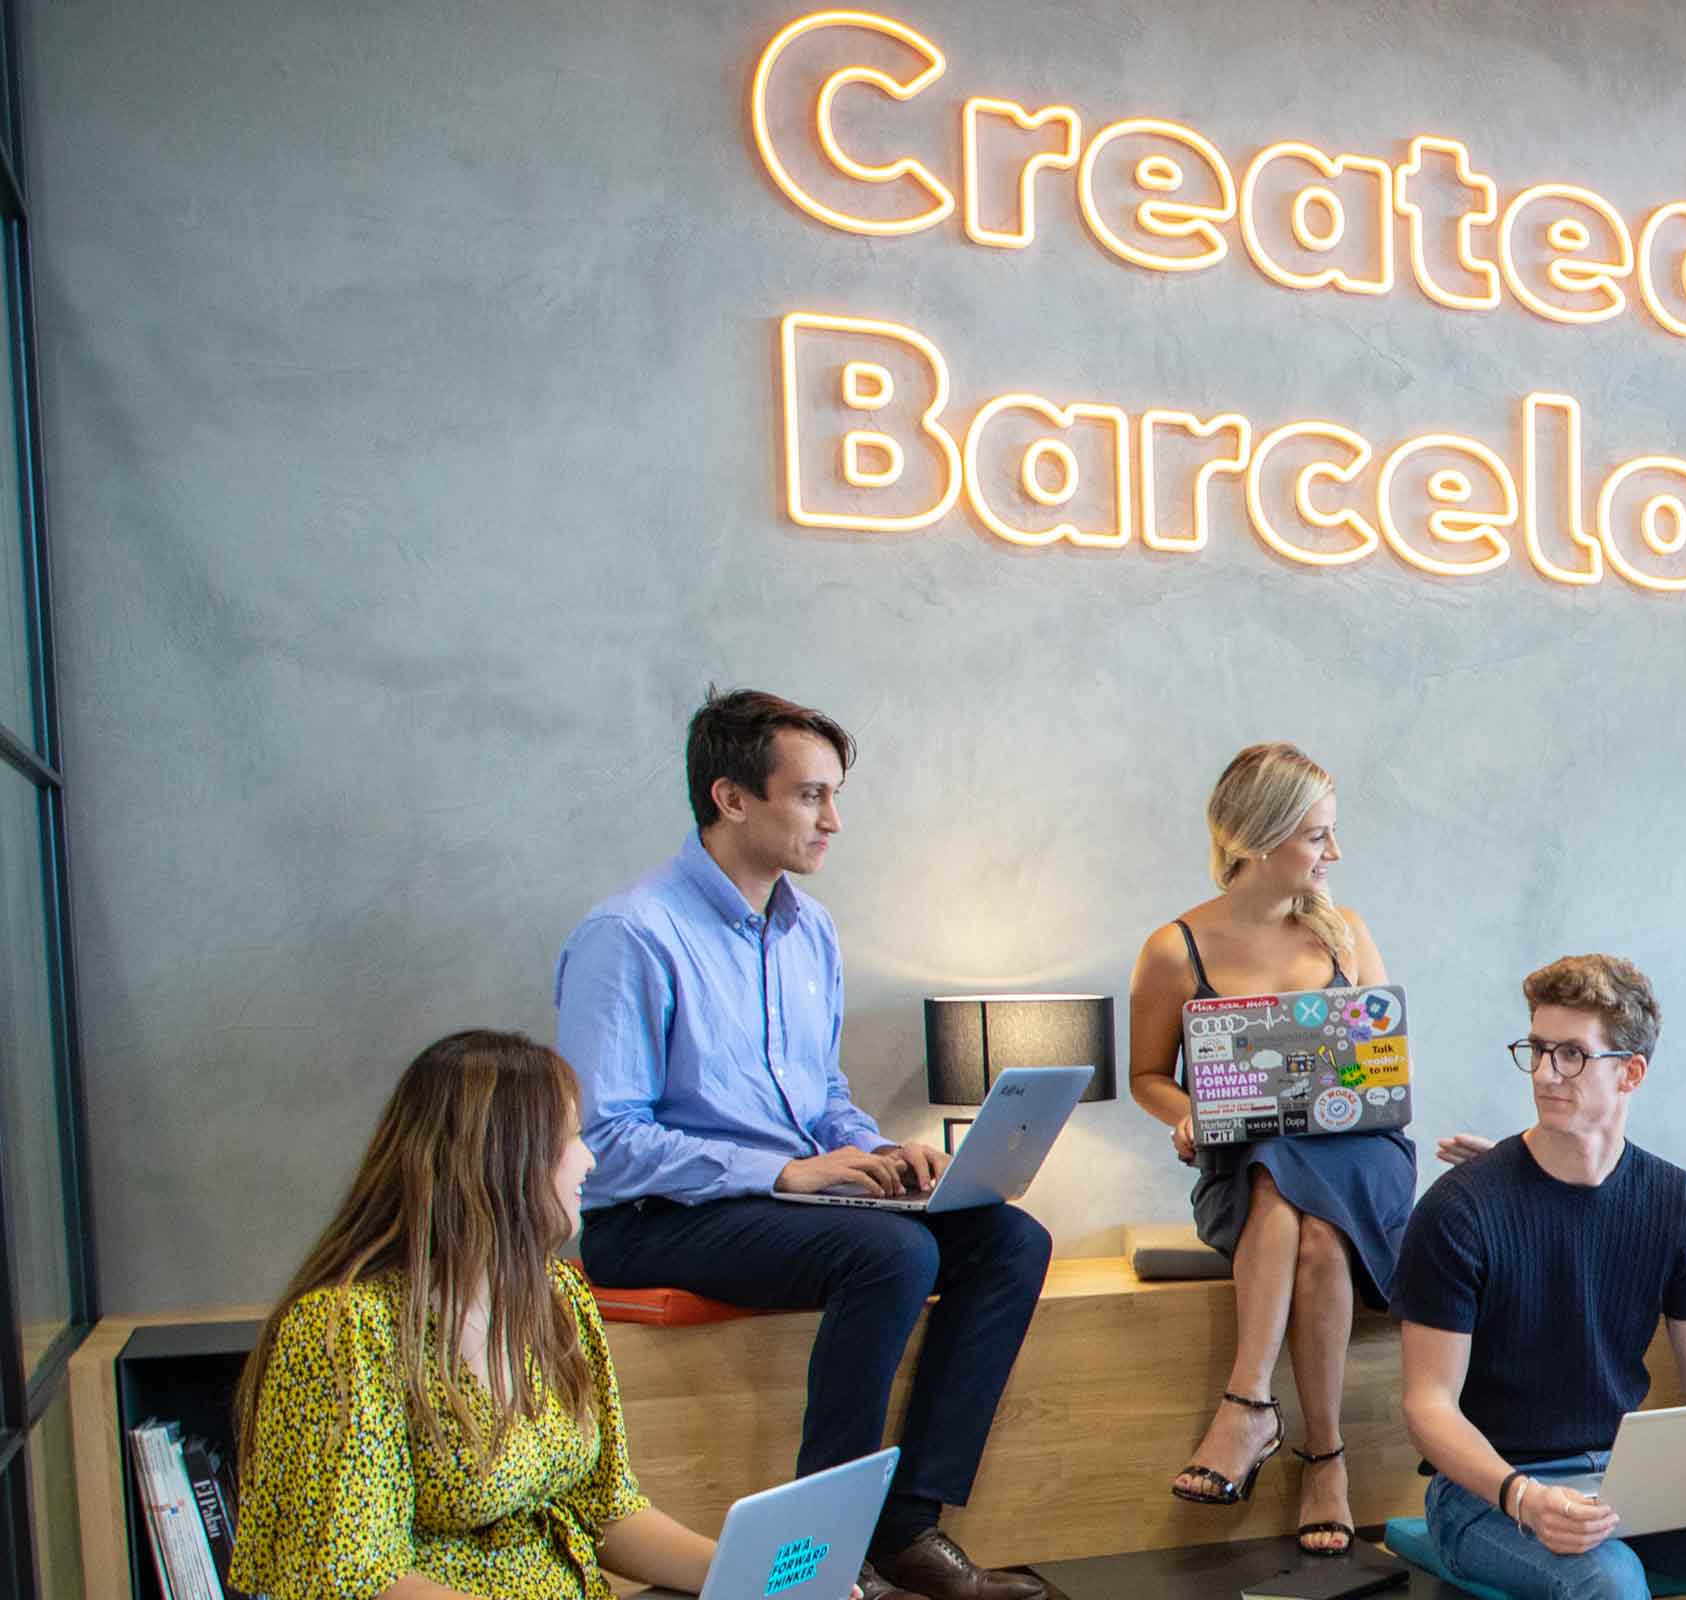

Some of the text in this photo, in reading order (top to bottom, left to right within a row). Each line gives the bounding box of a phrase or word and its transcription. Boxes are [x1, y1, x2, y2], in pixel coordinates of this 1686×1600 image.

[1372, 1043, 1394, 1055] Talk
[1201, 1063, 1225, 1076] AM
[1228, 1062, 1238, 1074] A
[1369, 1064, 1400, 1076] to me
[1195, 1072, 1269, 1089] FORWARD
[1196, 1084, 1263, 1100] THINKER.
[782, 1542, 801, 1557] AM
[771, 1545, 829, 1577] FORWARD
